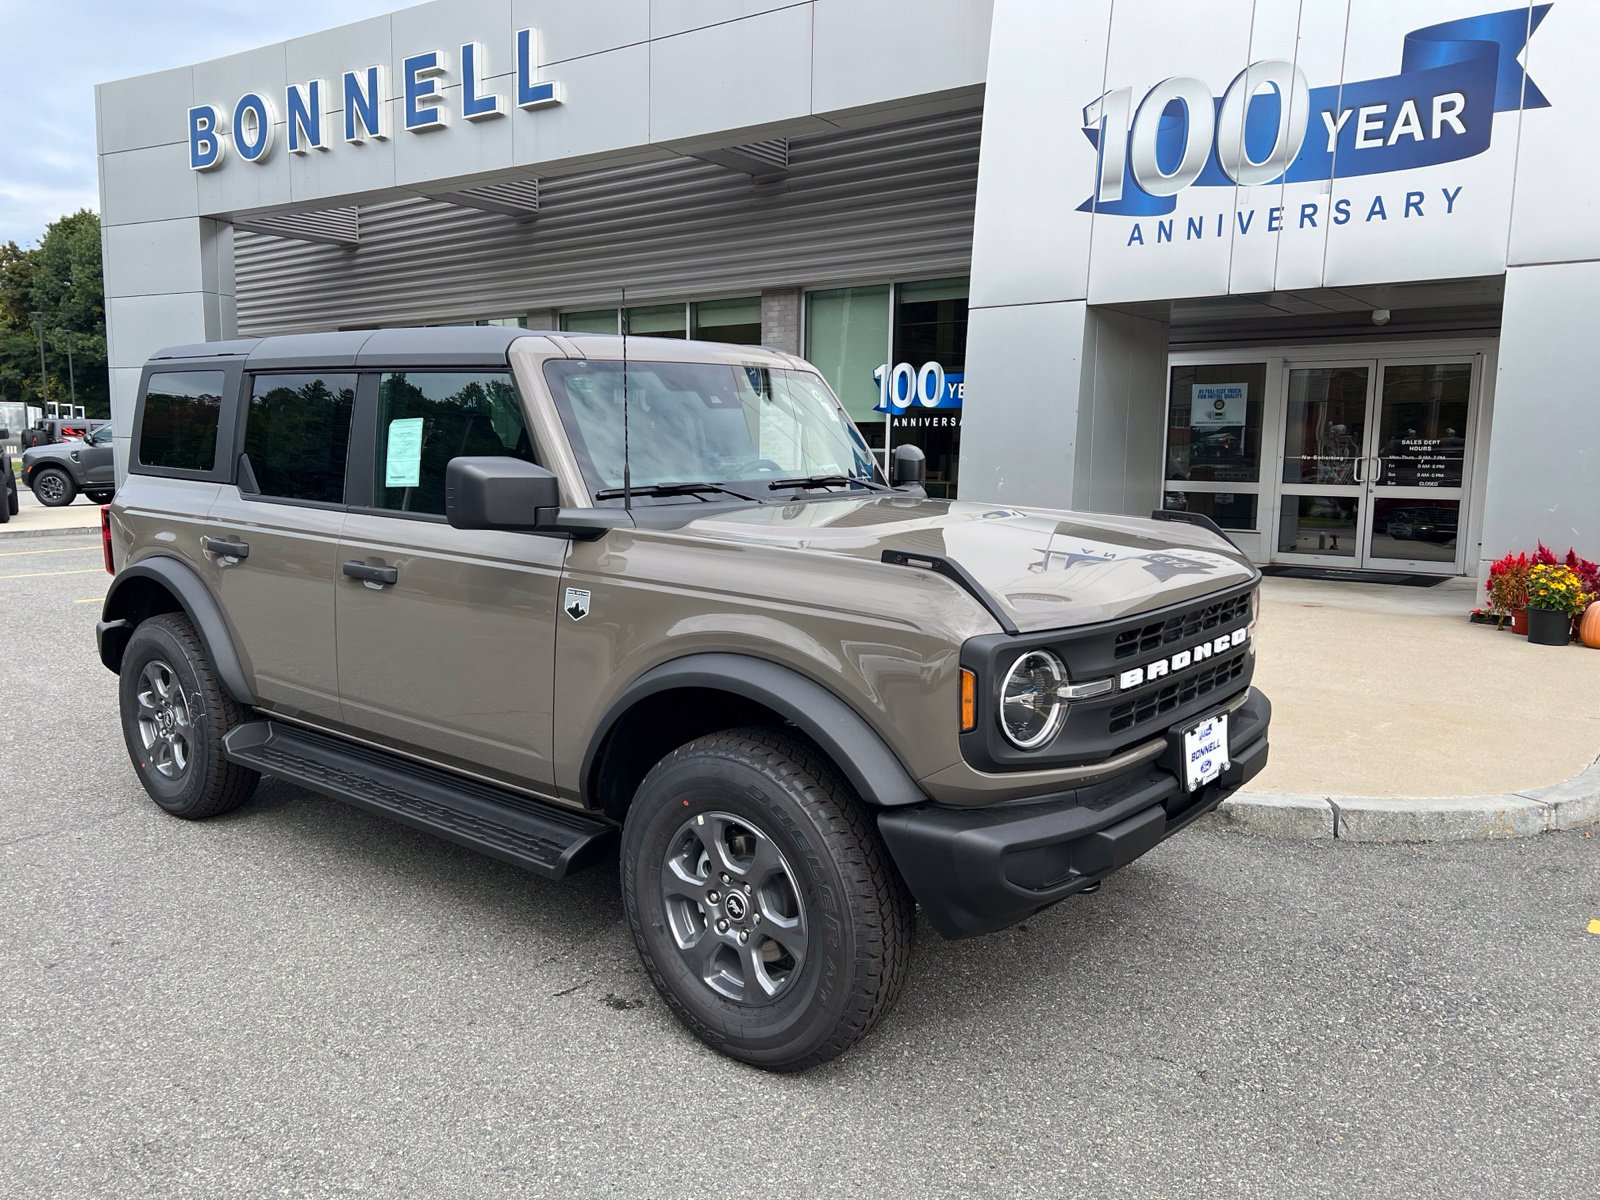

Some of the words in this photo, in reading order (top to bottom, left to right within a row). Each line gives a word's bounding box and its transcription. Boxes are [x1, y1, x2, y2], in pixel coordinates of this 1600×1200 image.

[187, 27, 562, 171] BONNELL
[1083, 58, 1310, 203] 100
[1320, 92, 1467, 153] YEAR
[1127, 186, 1463, 247] ANNIVERSARY
[873, 361, 945, 408] 100
[1313, 454, 1344, 462] Soliciting
[1120, 627, 1248, 690] BRONCO
[1191, 739, 1221, 762] BONNELL
